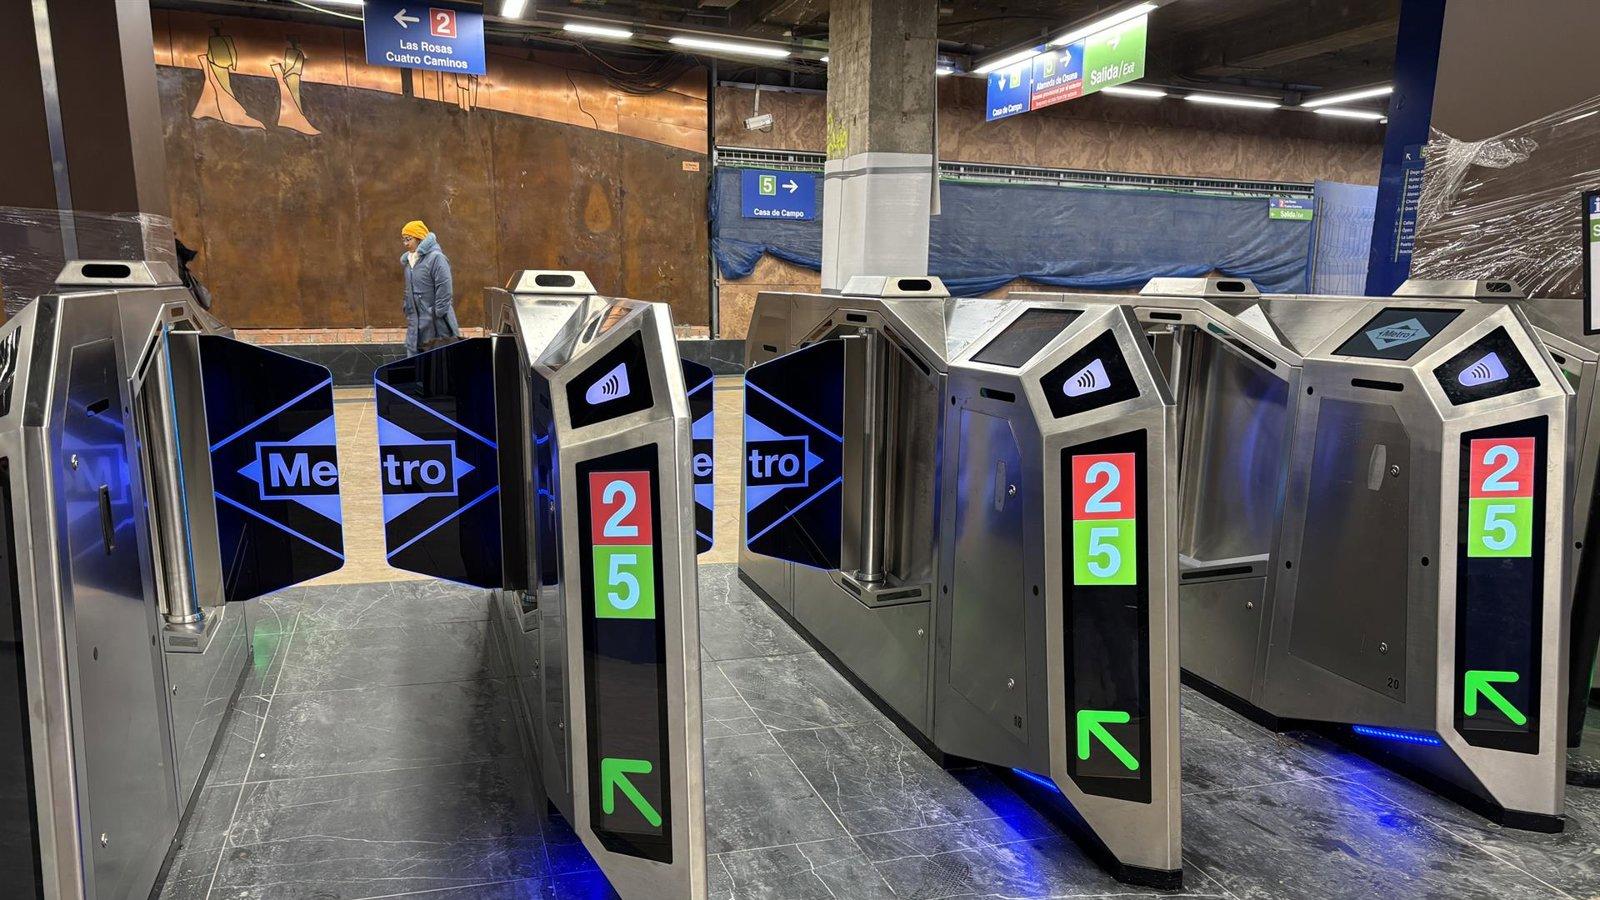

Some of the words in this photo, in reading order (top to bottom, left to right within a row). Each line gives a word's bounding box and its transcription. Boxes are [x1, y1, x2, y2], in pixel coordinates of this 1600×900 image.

[436, 12, 451, 34] 2
[386, 51, 421, 64] Cuatro
[423, 55, 468, 69] Caminos
[400, 39, 418, 51] Las
[421, 41, 453, 54] Rosas
[992, 107, 1003, 117] Casa
[1003, 106, 1008, 114] de
[1008, 103, 1023, 113] Campo
[763, 177, 773, 193] 5
[753, 208, 771, 216] Casa
[781, 209, 804, 219] Campo
[1382, 329, 1411, 339] Metro
[269, 452, 338, 487] Me
[383, 454, 446, 485] tro
[749, 449, 800, 478] tro
[1481, 445, 1519, 492] 2
[1084, 462, 1121, 513] 2
[602, 480, 639, 537] 2
[1481, 504, 1517, 550] 5
[1087, 527, 1121, 578] 5
[607, 554, 640, 610] 5
[1387, 677, 1399, 690] 20
